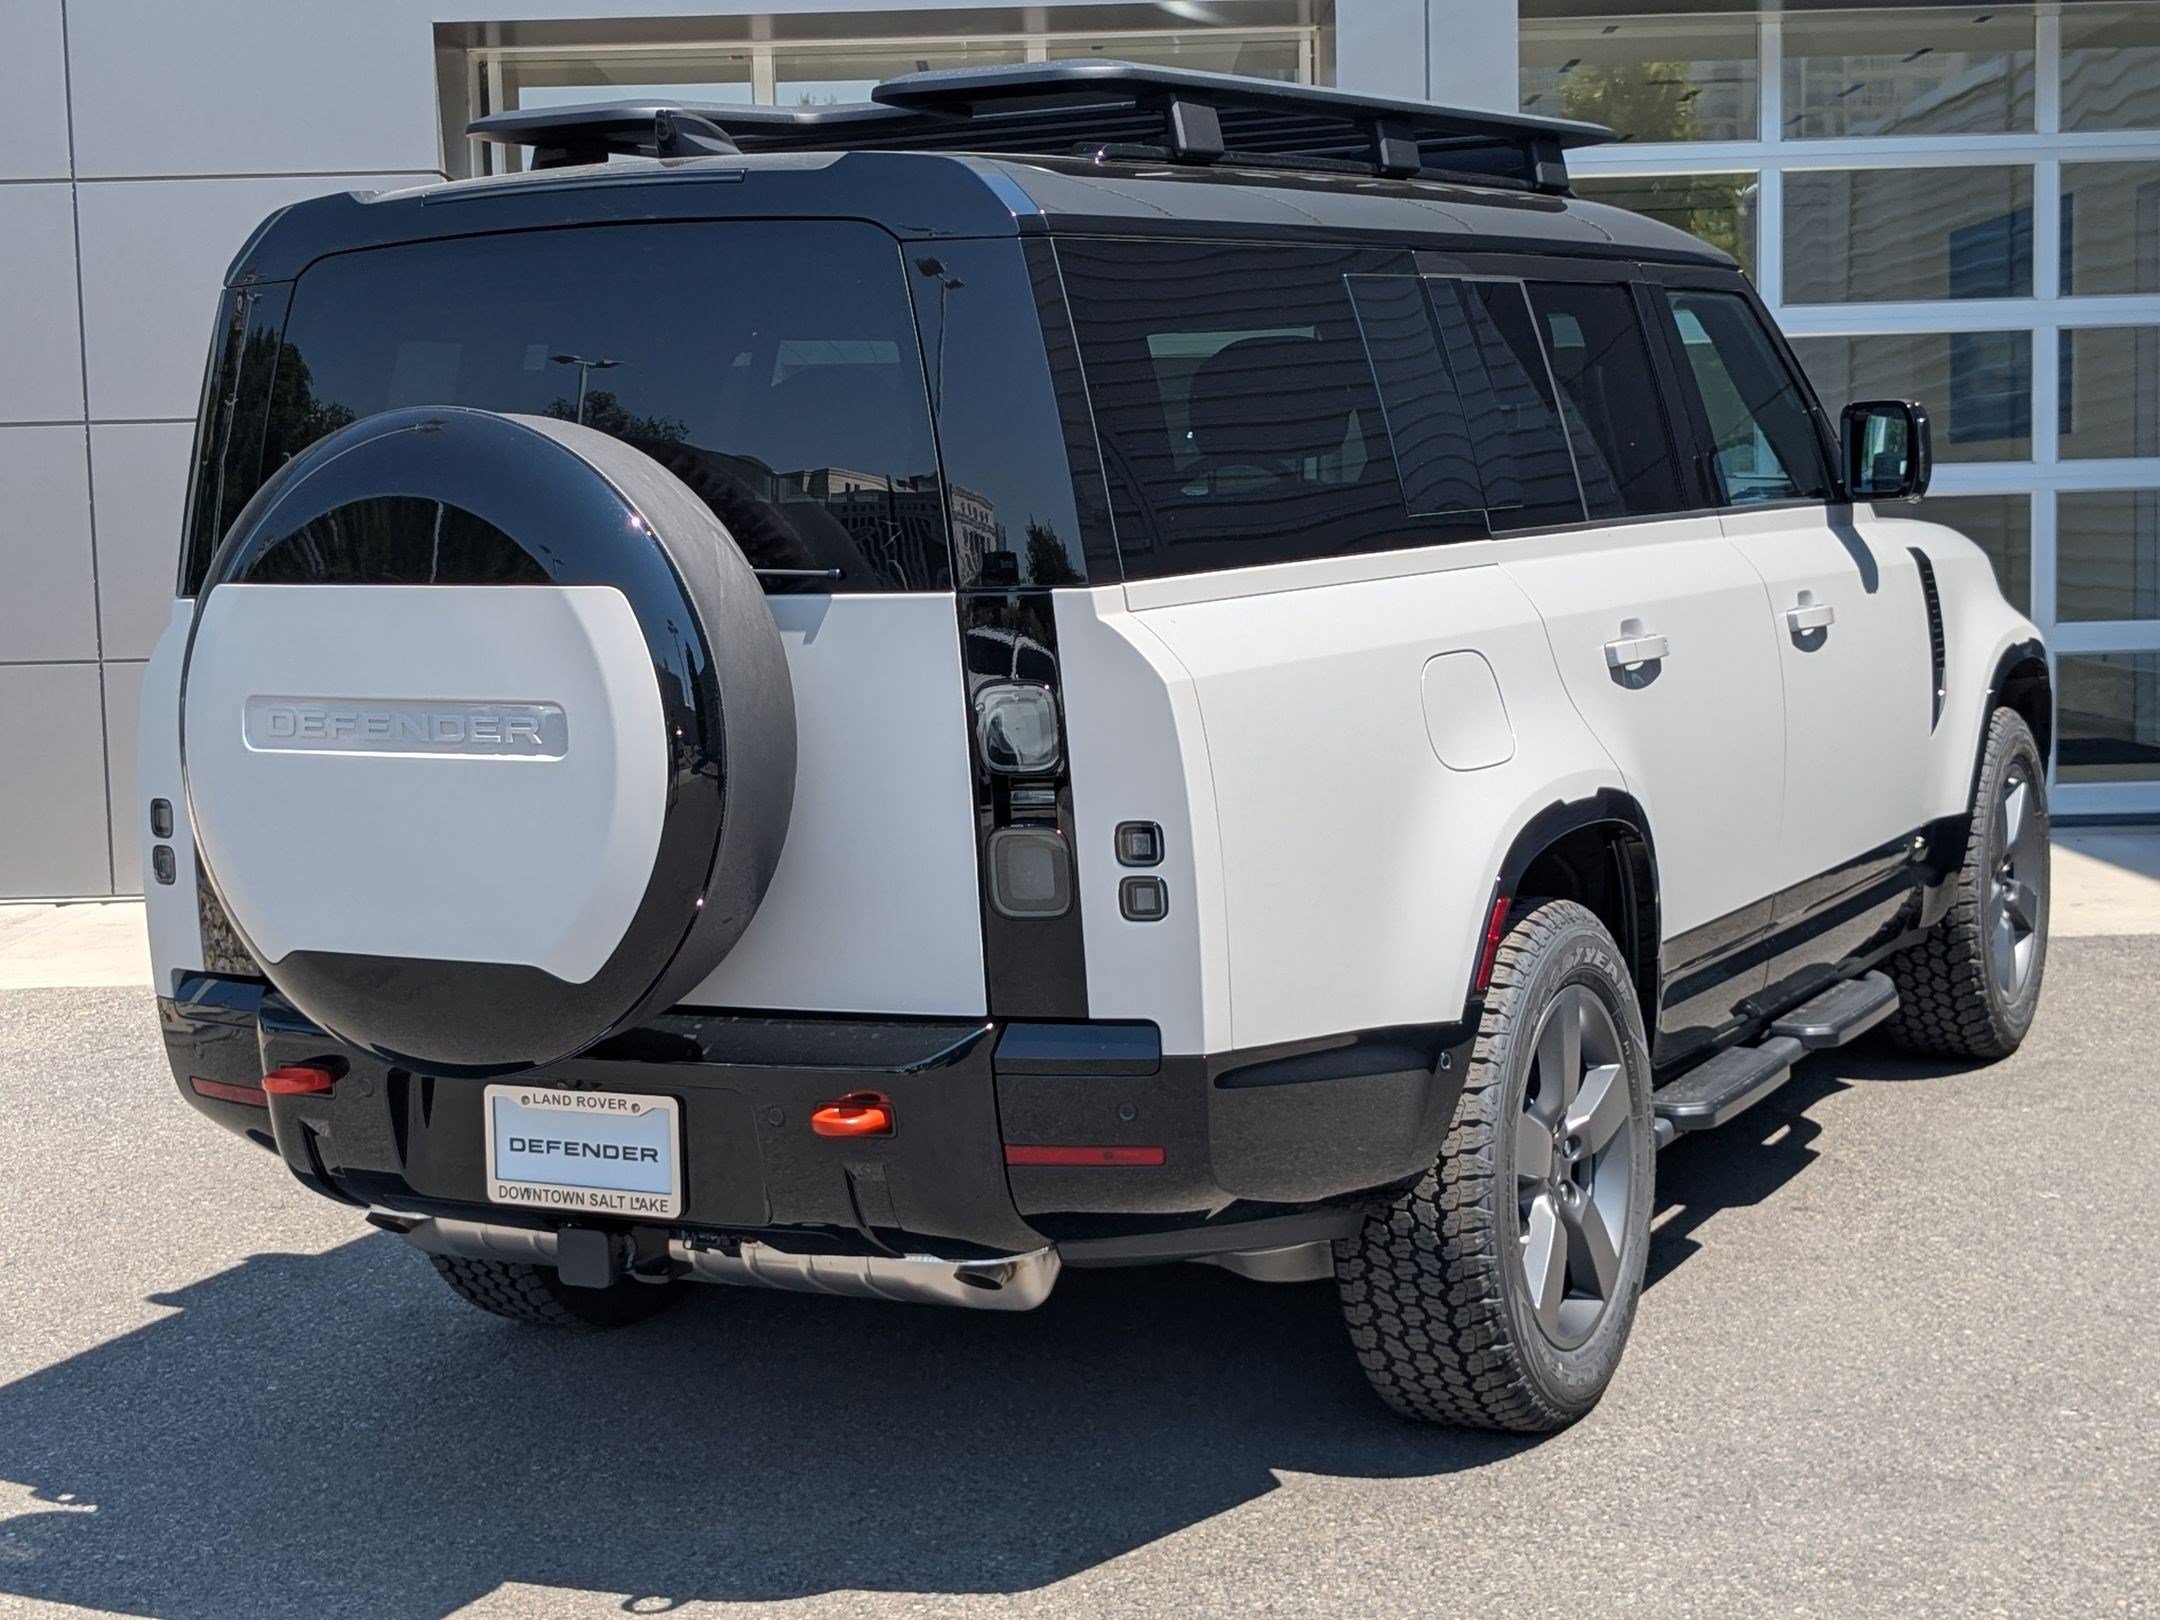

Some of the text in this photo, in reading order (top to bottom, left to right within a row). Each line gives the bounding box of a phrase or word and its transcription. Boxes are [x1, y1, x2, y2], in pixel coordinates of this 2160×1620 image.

[266, 706, 543, 745] DEFENDER
[532, 1093, 628, 1110] LAND ROVER
[509, 1137, 659, 1163] DEFENDER
[499, 1185, 669, 1213] DOWNTOWN SALT LAKE
